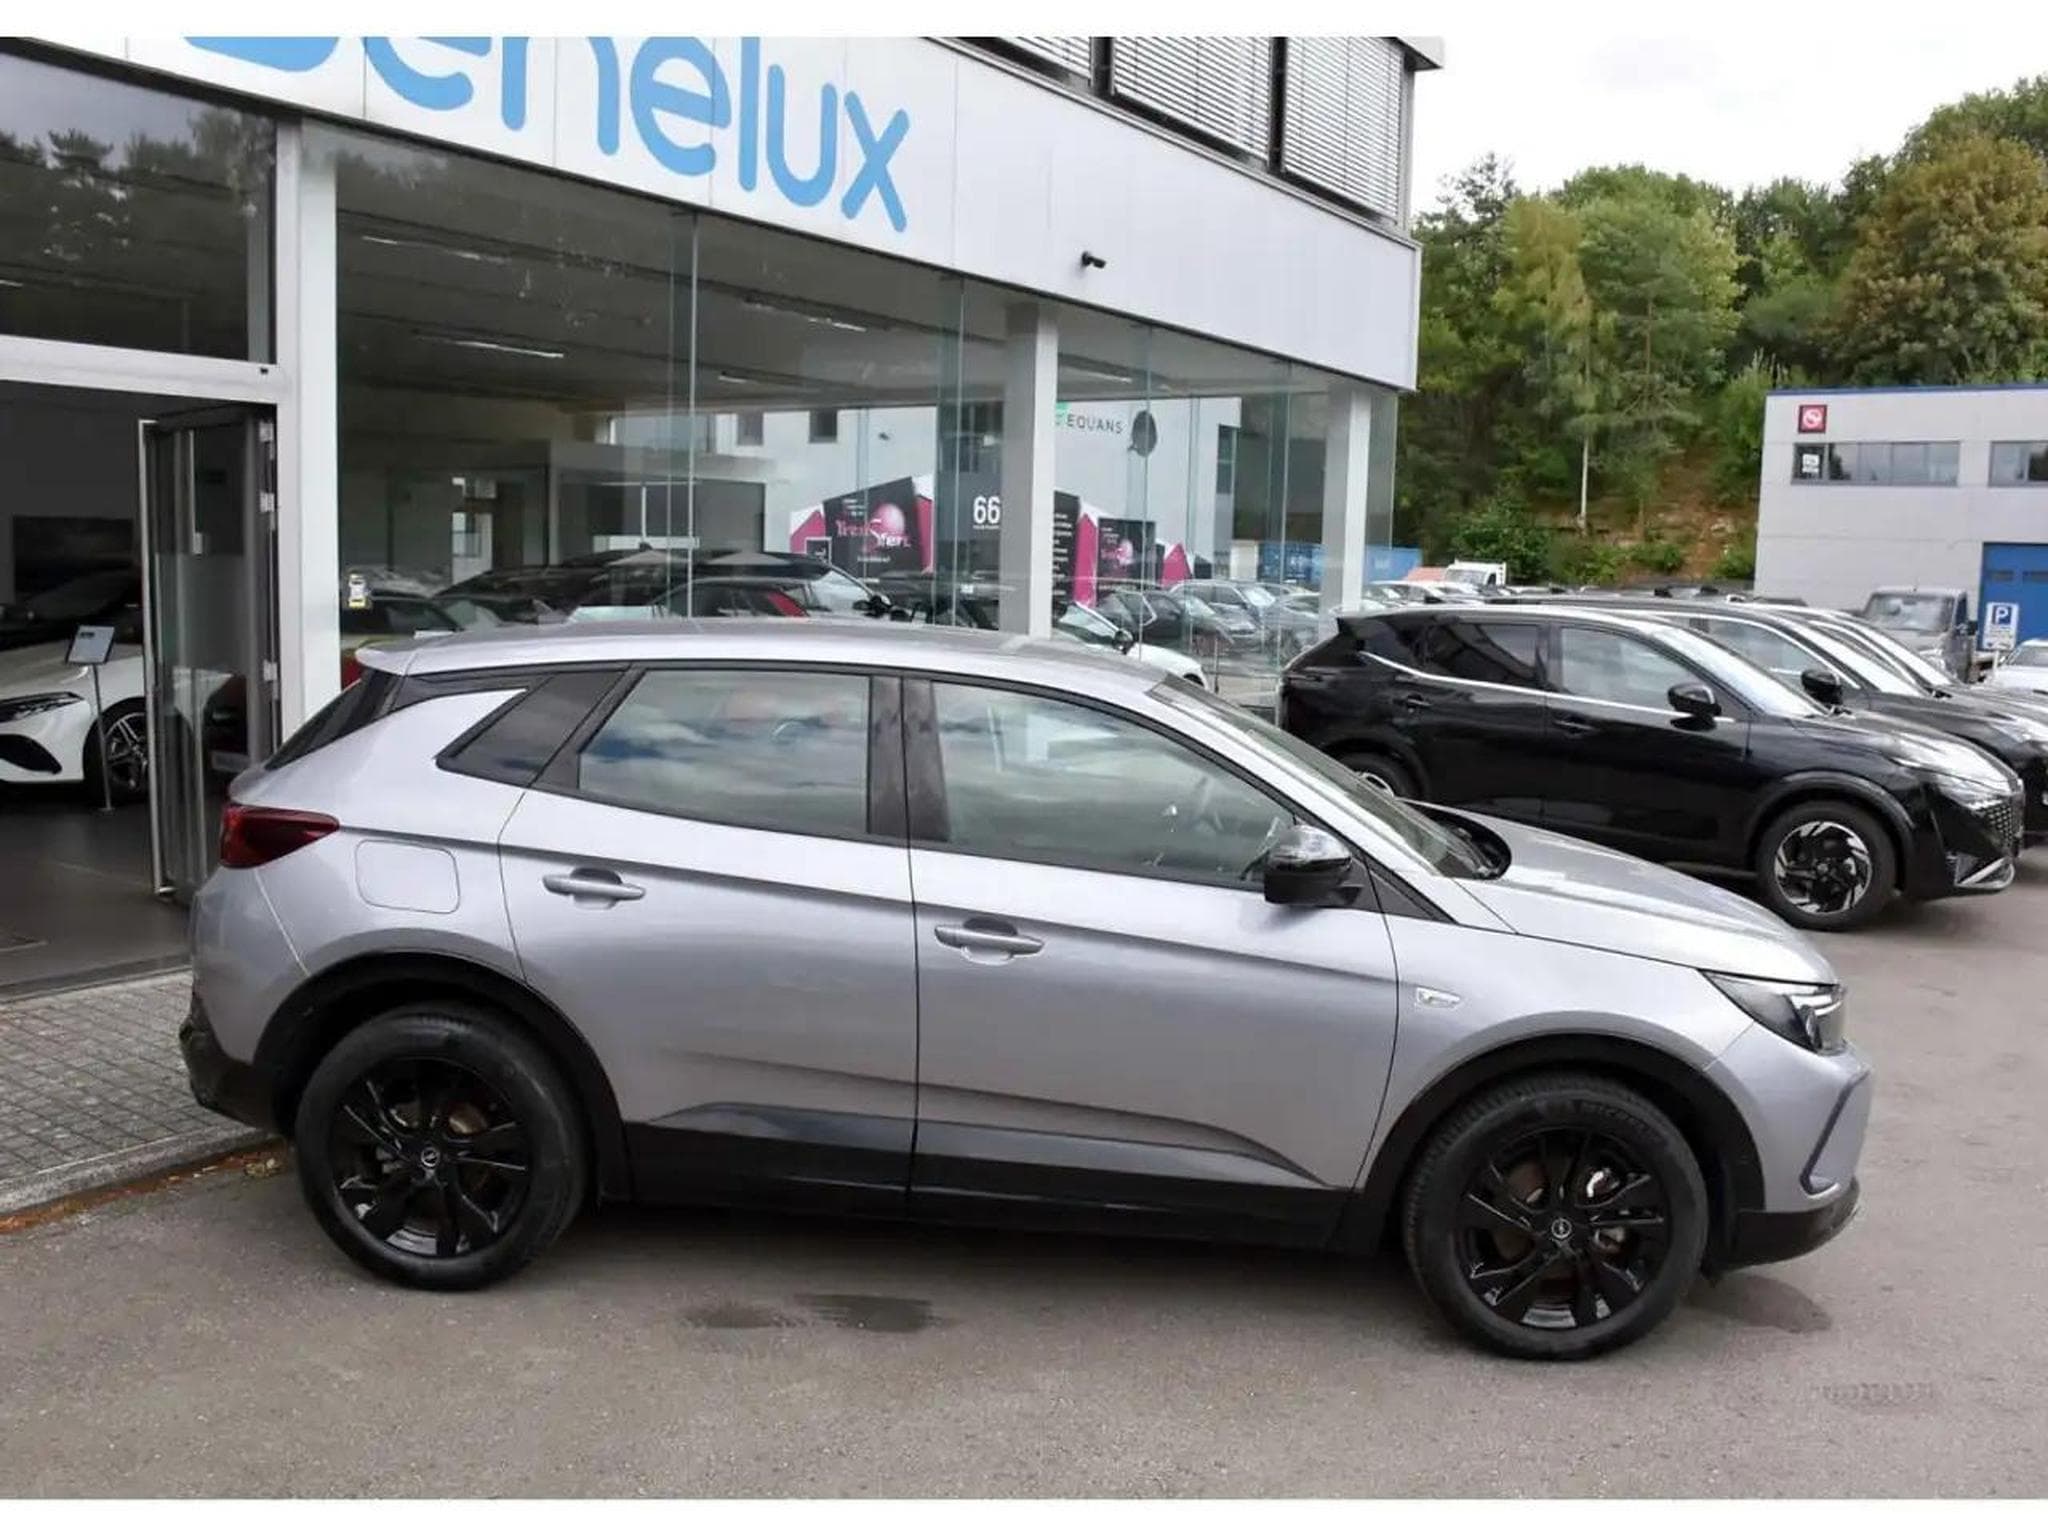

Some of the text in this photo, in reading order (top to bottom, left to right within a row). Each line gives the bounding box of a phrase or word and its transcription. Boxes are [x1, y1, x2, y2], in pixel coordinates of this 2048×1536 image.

[183, 36, 910, 232] enelux
[1066, 413, 1124, 434] EQUANS
[973, 495, 1001, 524] 66
[1994, 605, 2009, 625] P
